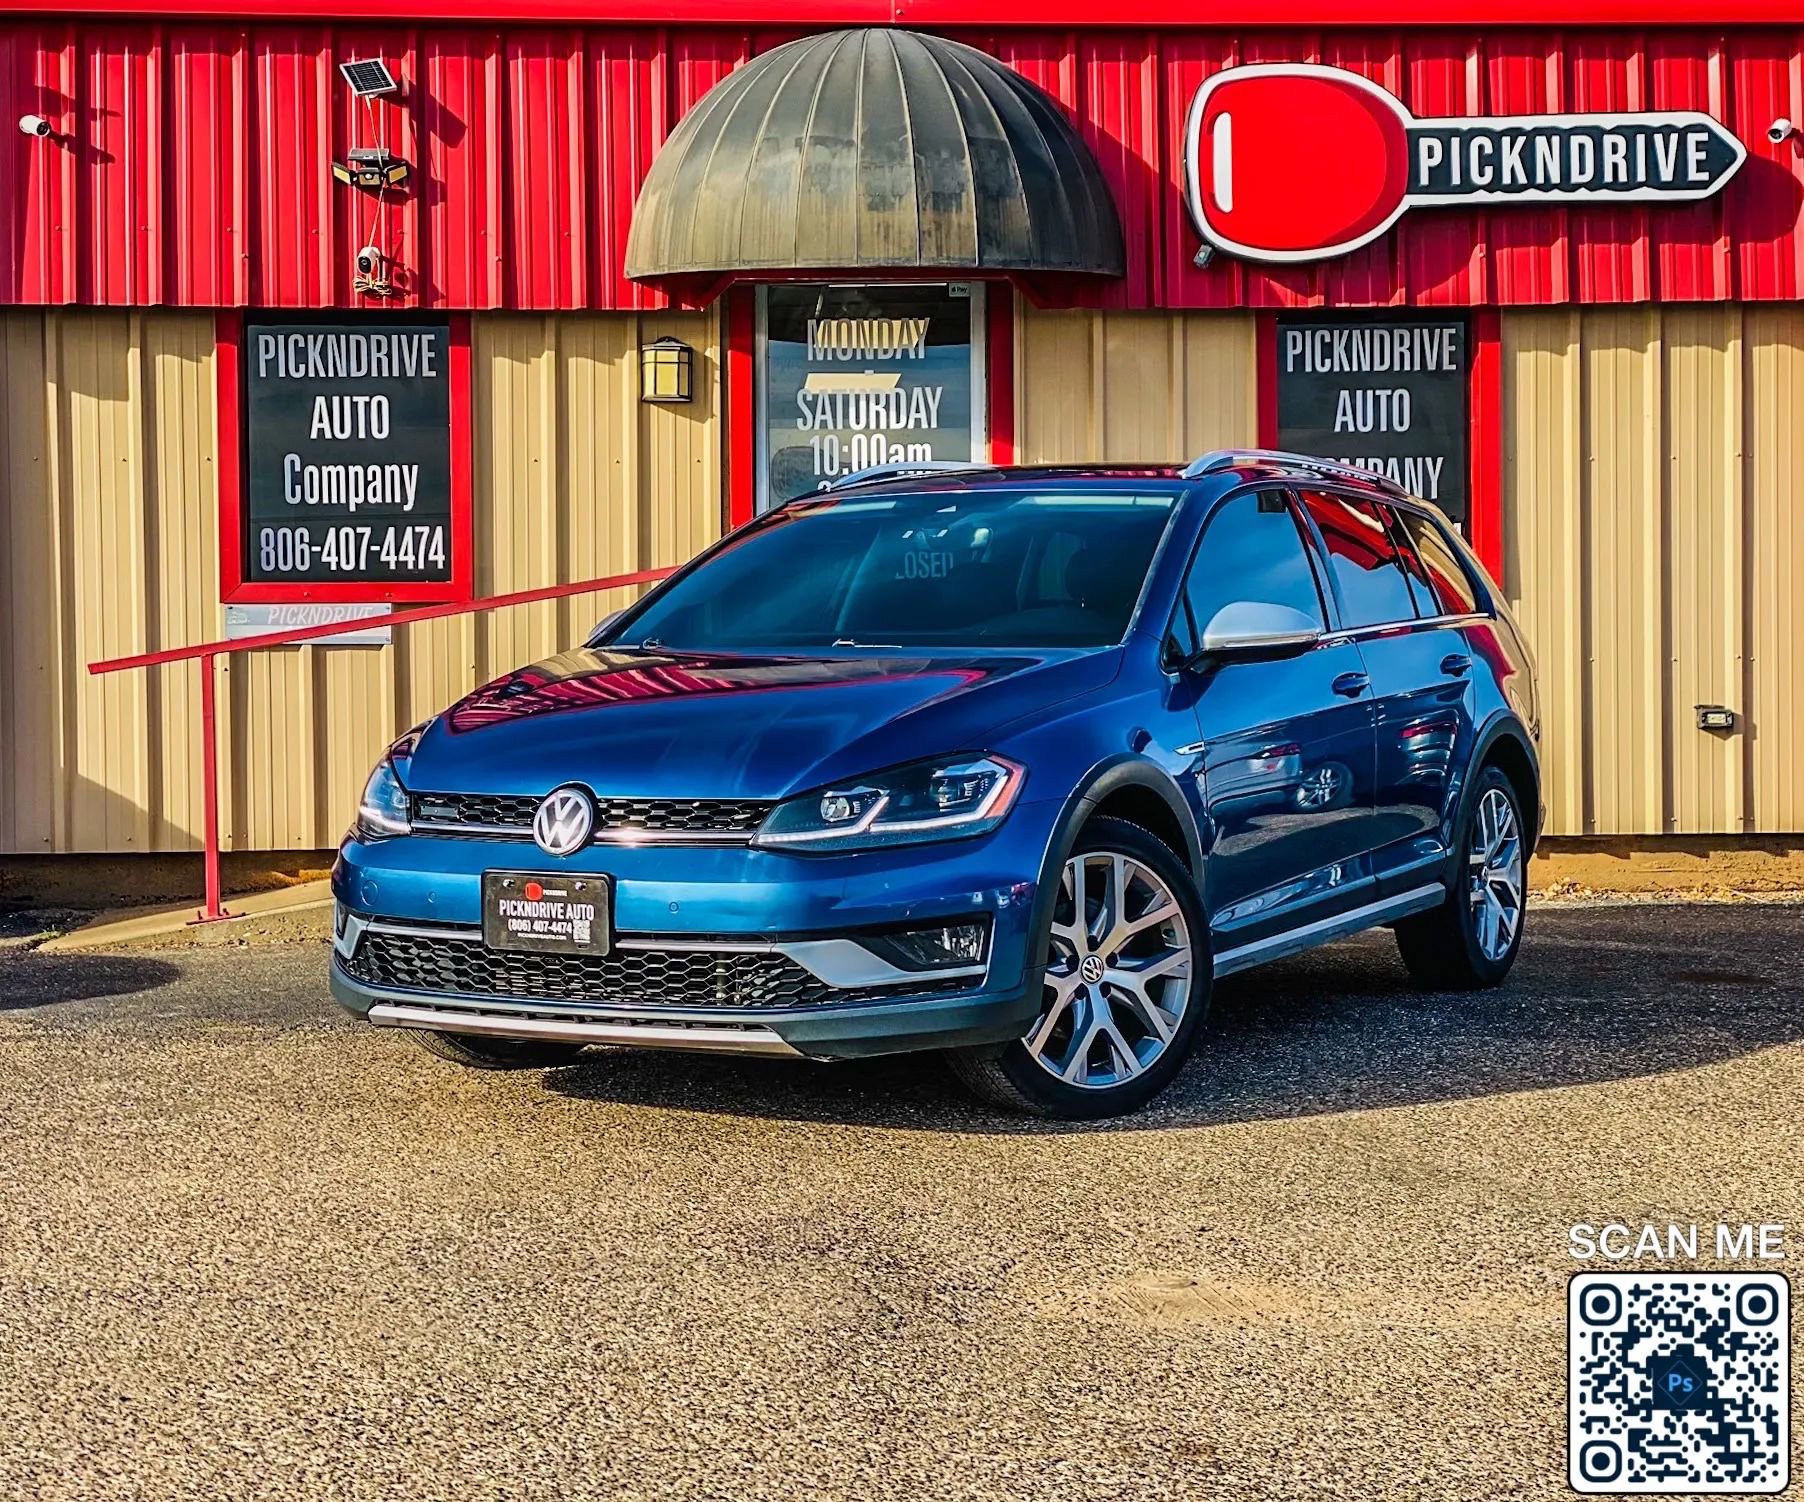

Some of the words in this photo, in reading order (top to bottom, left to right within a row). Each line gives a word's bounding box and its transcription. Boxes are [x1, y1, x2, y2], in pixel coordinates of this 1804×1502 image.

[1418, 132, 1711, 187] PICKNDRIVE
[258, 334, 437, 378] PICKNDRIVE
[807, 317, 931, 361] MONDAY
[1286, 328, 1457, 373] PICKNDRIVE
[309, 395, 390, 439] AUTO
[796, 386, 943, 431] SATURDAY
[1334, 388, 1411, 433] AUTO
[283, 453, 419, 512] Company
[260, 525, 446, 572] 806-407-4474
[499, 899, 564, 920] PICKNDRIVE
[565, 903, 595, 921] AUTO
[507, 918, 531, 932] (806)
[532, 920, 572, 934] 407-4474
